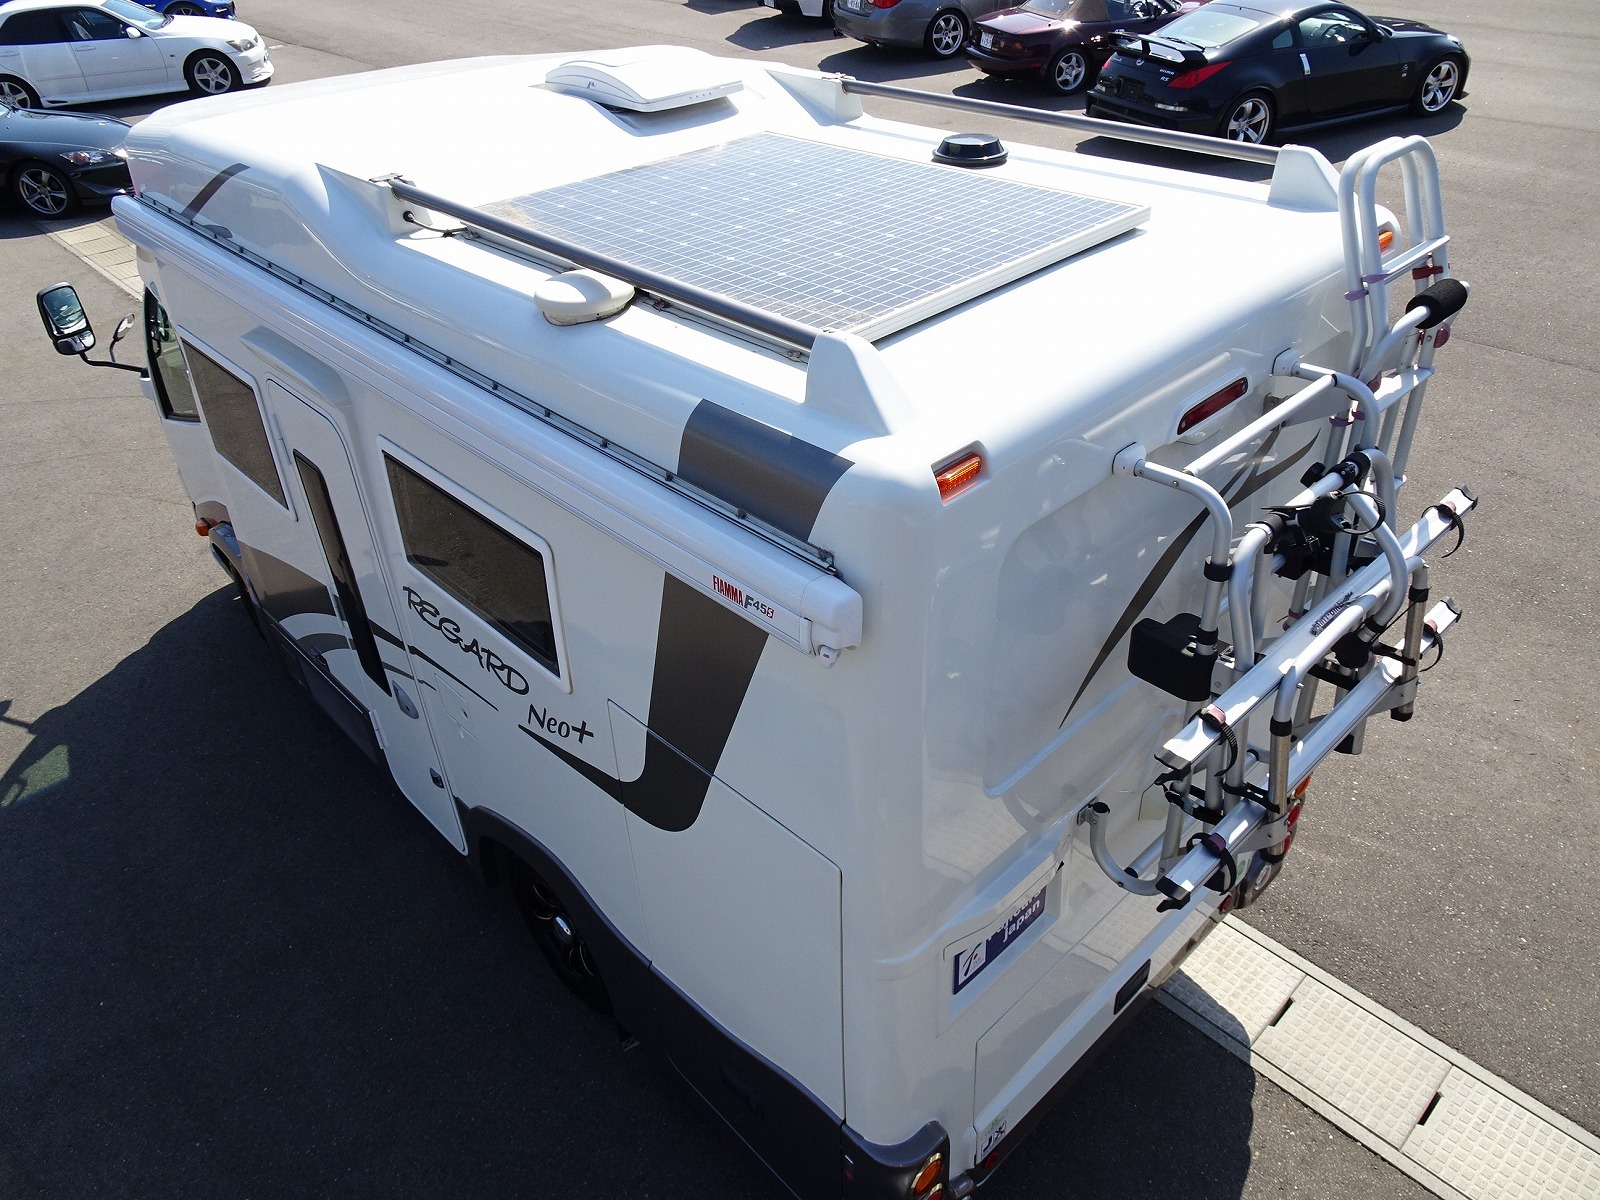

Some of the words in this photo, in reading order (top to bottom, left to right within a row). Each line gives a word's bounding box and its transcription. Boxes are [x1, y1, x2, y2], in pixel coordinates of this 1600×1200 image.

[713, 574, 744, 607] FIAMMA
[402, 585, 530, 696] REGARD
[528, 703, 595, 744] Neo+
[1003, 899, 1040, 943] japan
